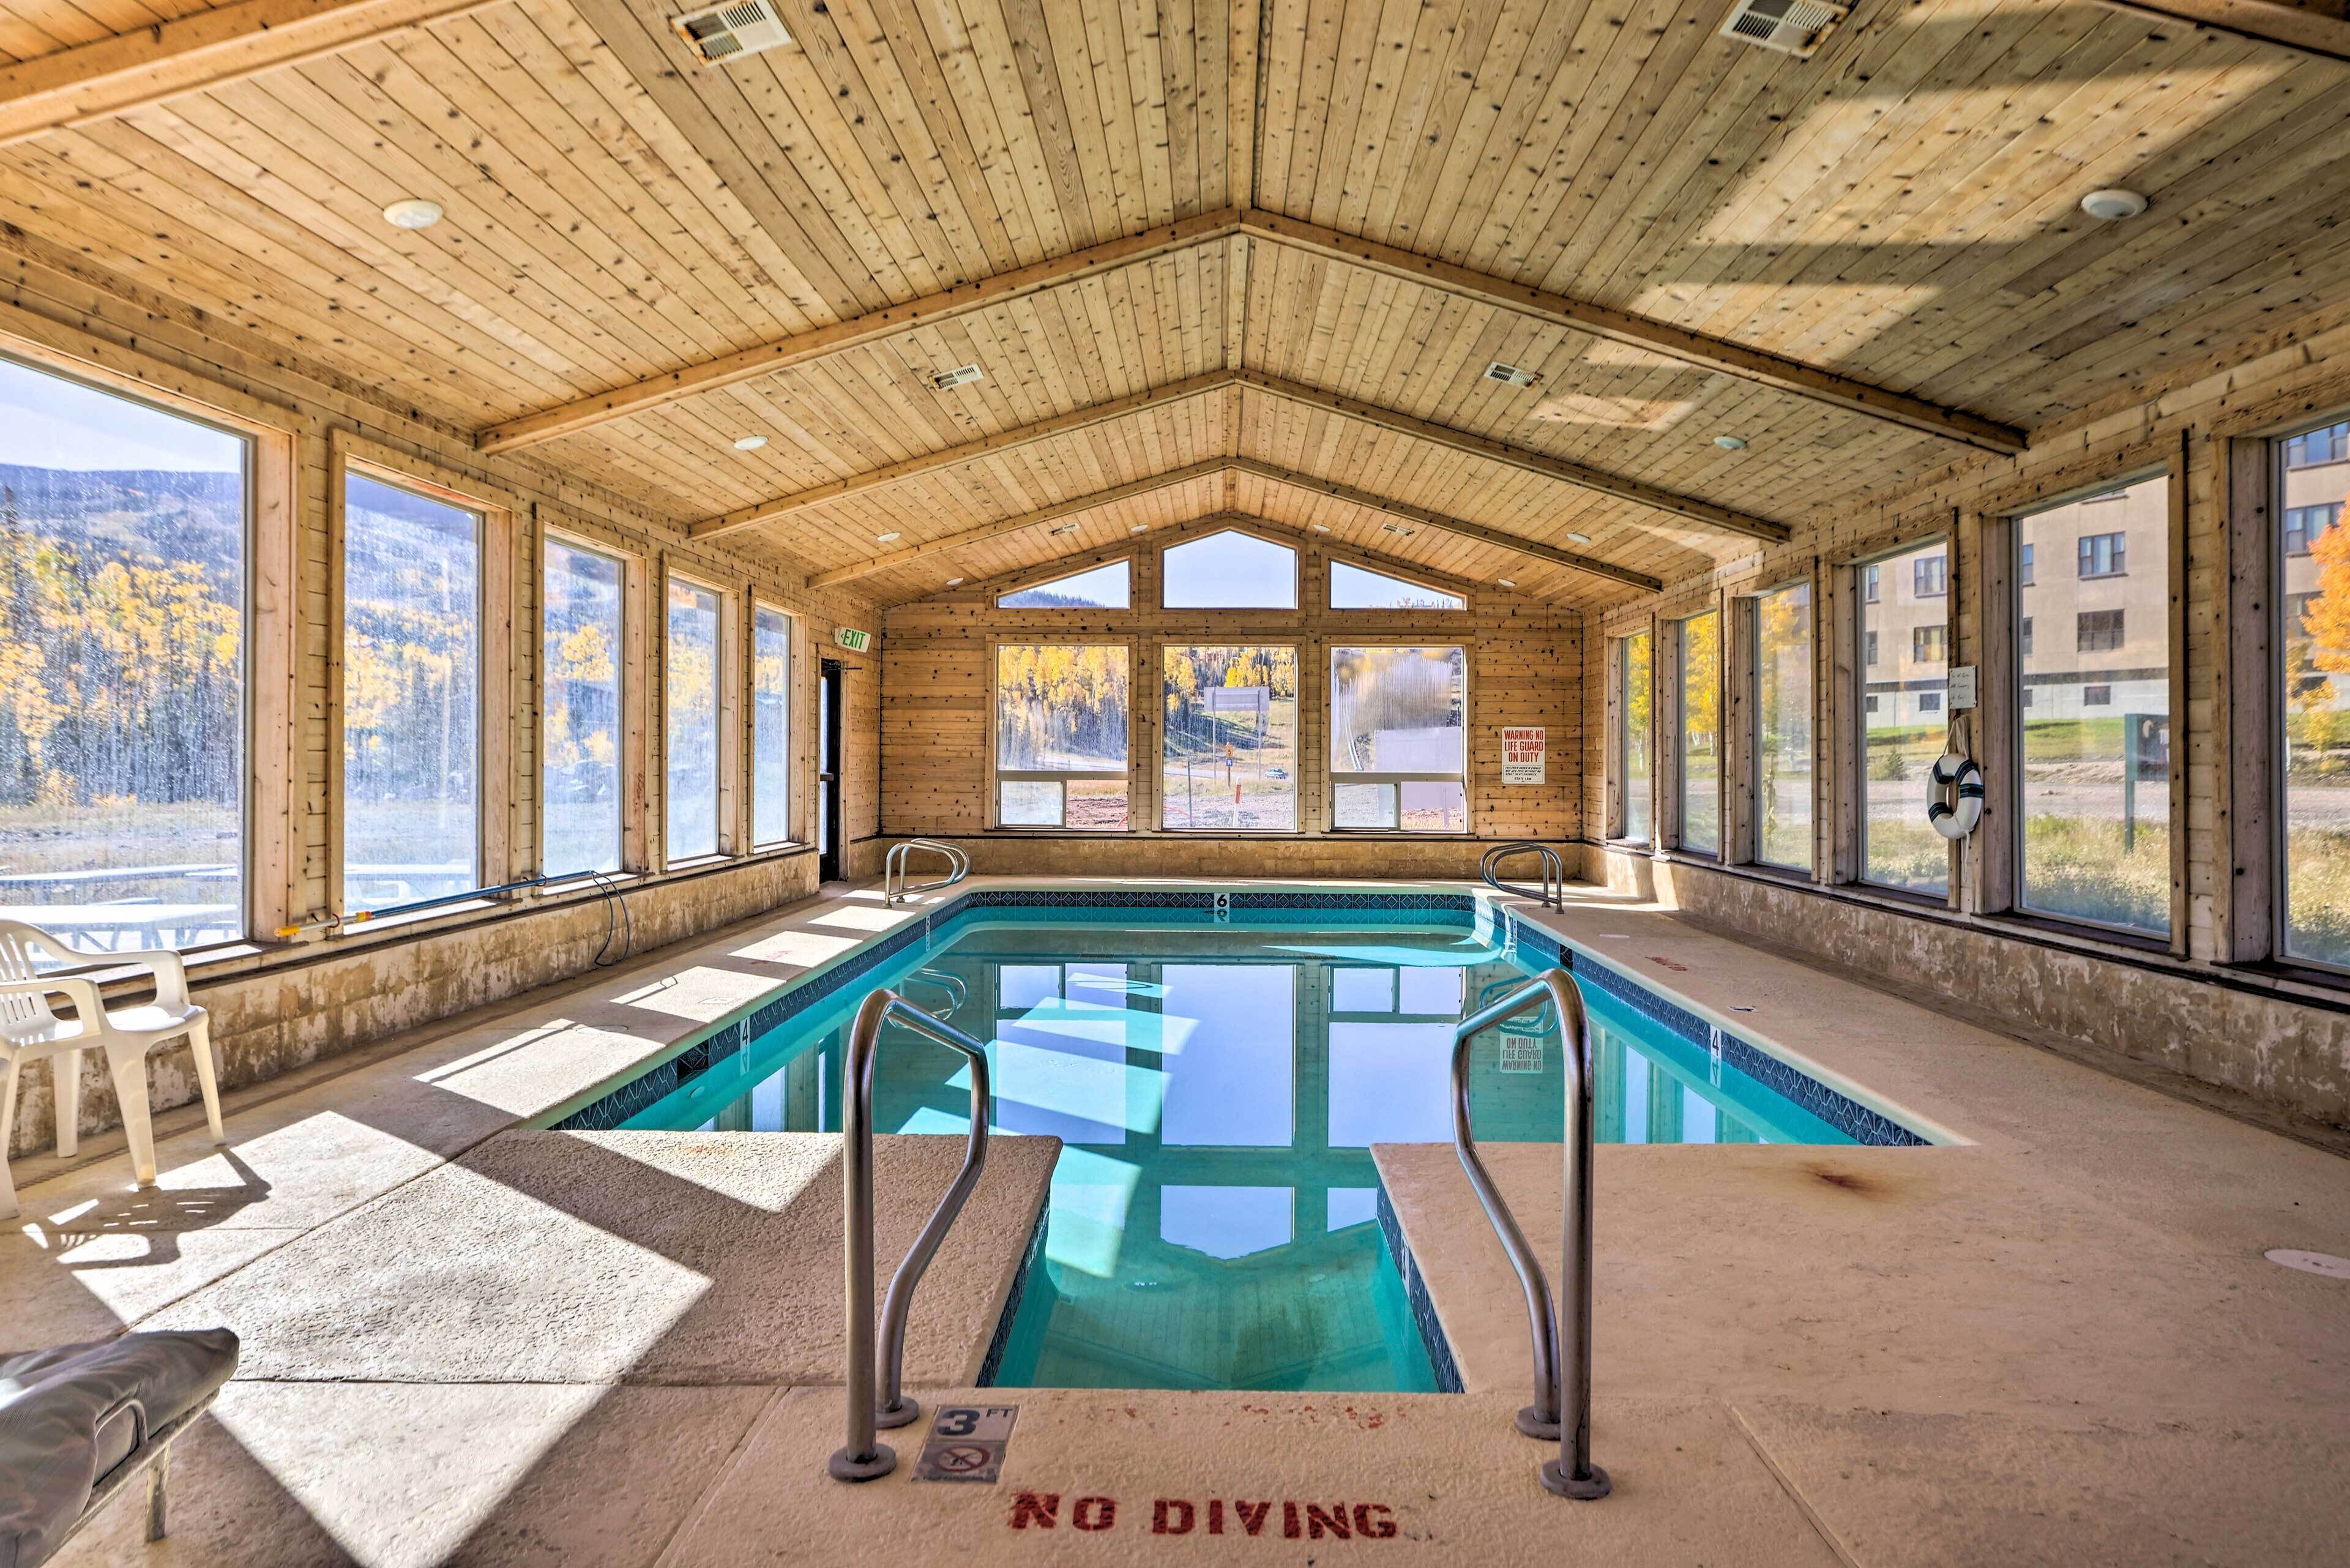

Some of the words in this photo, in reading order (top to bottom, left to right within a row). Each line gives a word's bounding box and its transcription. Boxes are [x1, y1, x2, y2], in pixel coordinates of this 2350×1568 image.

[842, 629, 866, 649] EXIT
[1504, 730, 1534, 741] WARNING
[1535, 730, 1543, 741] NO
[1504, 741, 1518, 752] LIFE
[1520, 741, 1543, 752] GUARD
[1509, 752, 1518, 763] ON
[1520, 752, 1539, 763] DUTY
[1217, 894, 1228, 908] 6
[742, 1019, 748, 1045] 4
[1712, 1029, 1719, 1056] 4
[937, 1409, 980, 1436] 3
[986, 1408, 1013, 1418] FT
[1011, 1491, 1117, 1531] NO
[1152, 1499, 1398, 1540] DIVING
